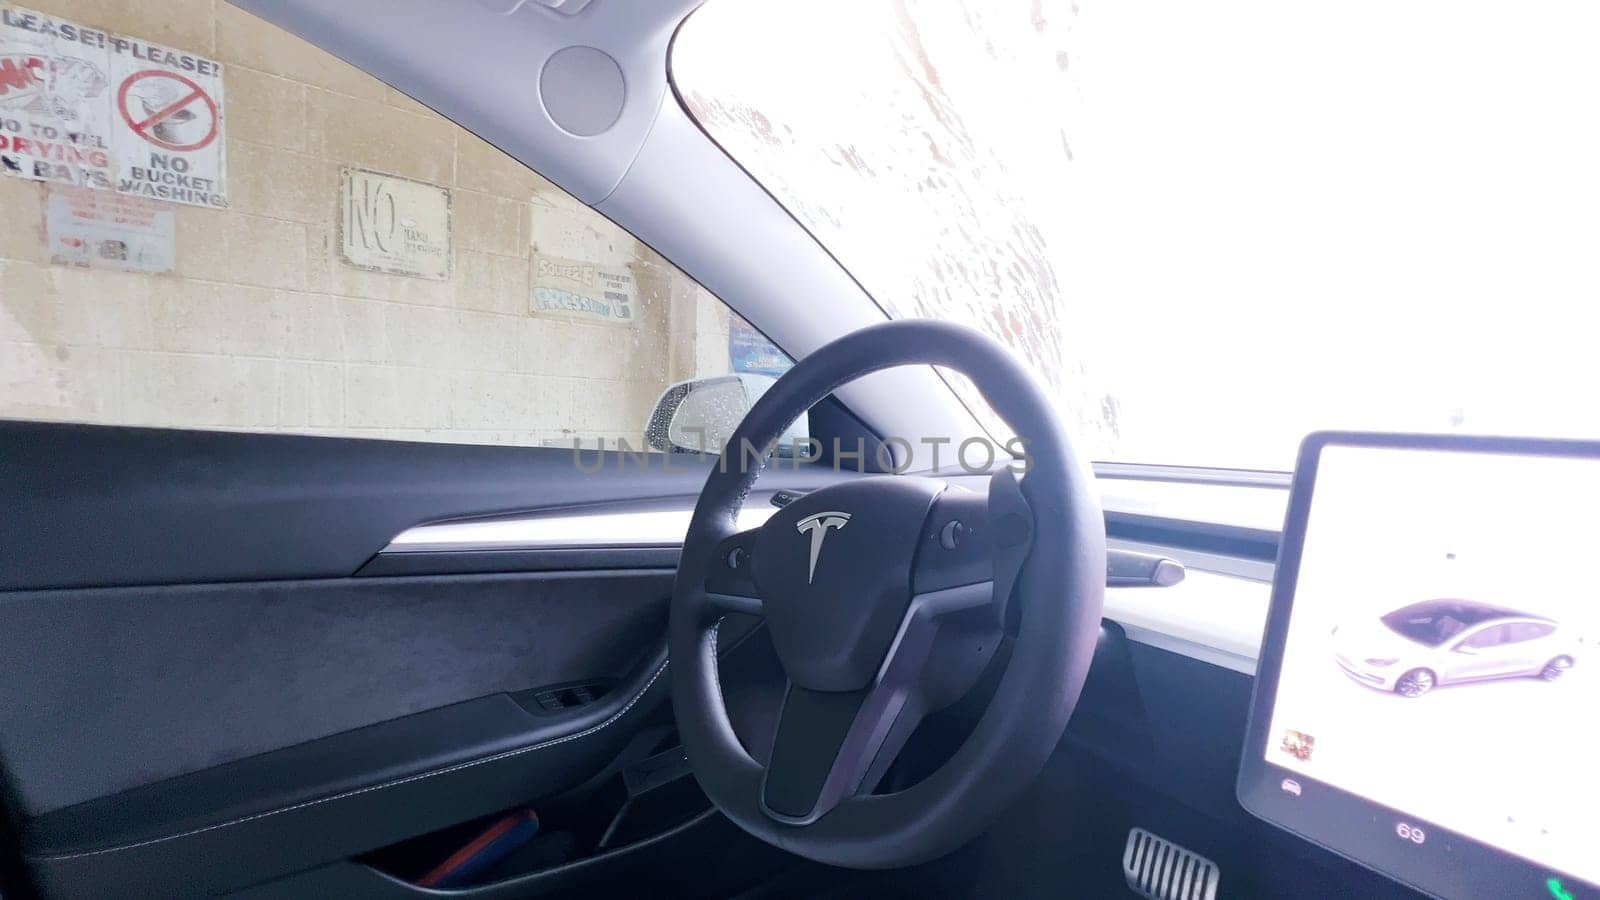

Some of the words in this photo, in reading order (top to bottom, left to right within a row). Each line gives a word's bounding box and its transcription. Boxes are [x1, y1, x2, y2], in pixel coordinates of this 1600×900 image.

[109, 35, 219, 77] PLEASE!
[151, 153, 189, 173] NO
[131, 166, 213, 191] BUCKET
[118, 179, 228, 208] WASHING
[349, 176, 395, 253] NO
[1396, 823, 1426, 845] 69
